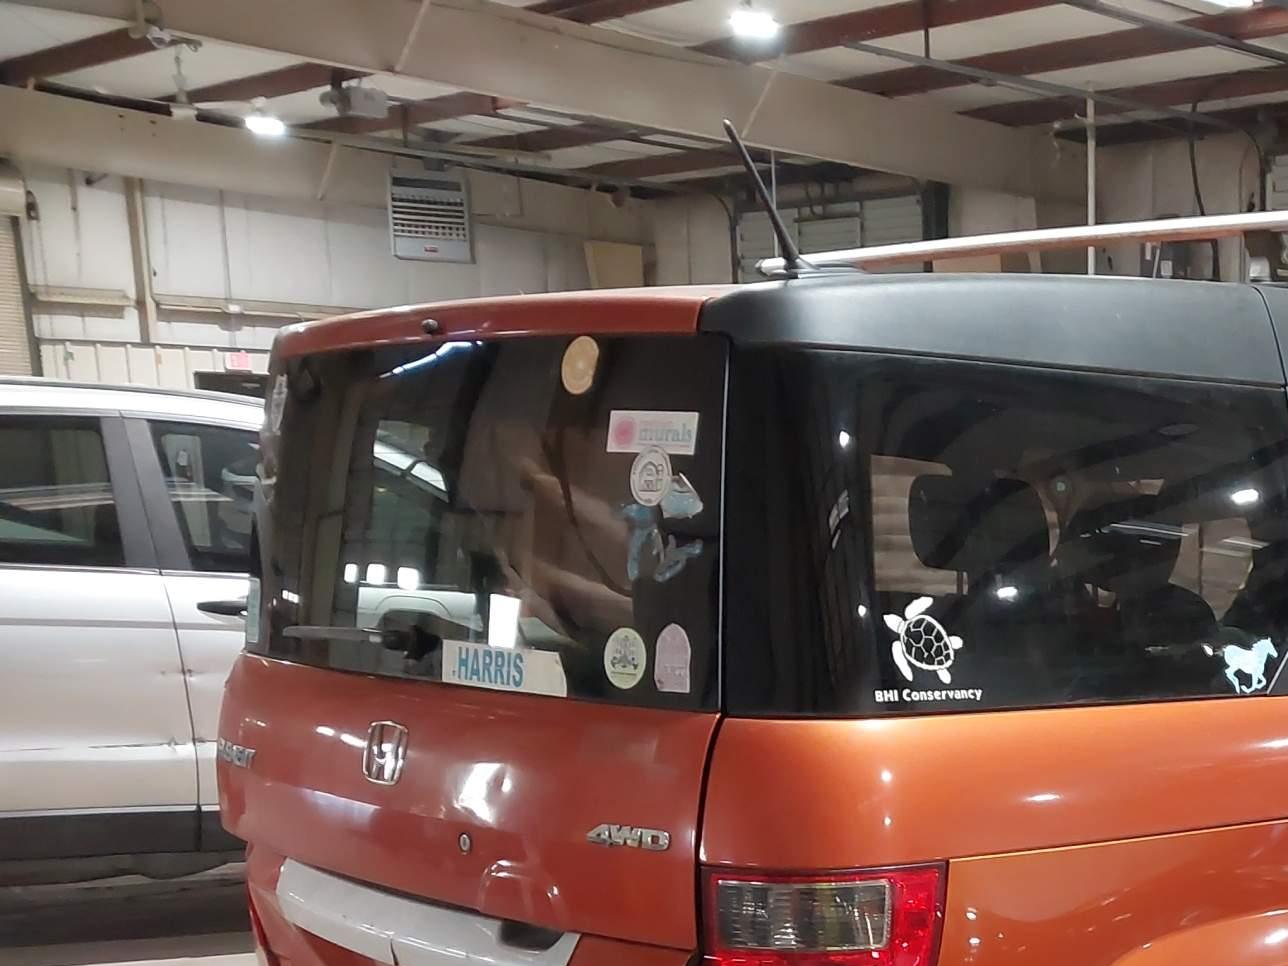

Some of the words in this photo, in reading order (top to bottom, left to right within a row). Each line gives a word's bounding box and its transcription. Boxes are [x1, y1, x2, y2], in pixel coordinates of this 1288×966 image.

[639, 423, 692, 441] murals
[457, 646, 524, 688] HARRIS
[874, 689, 899, 702] BHI
[902, 688, 983, 702] Conservancy
[586, 823, 670, 851] 4WD
